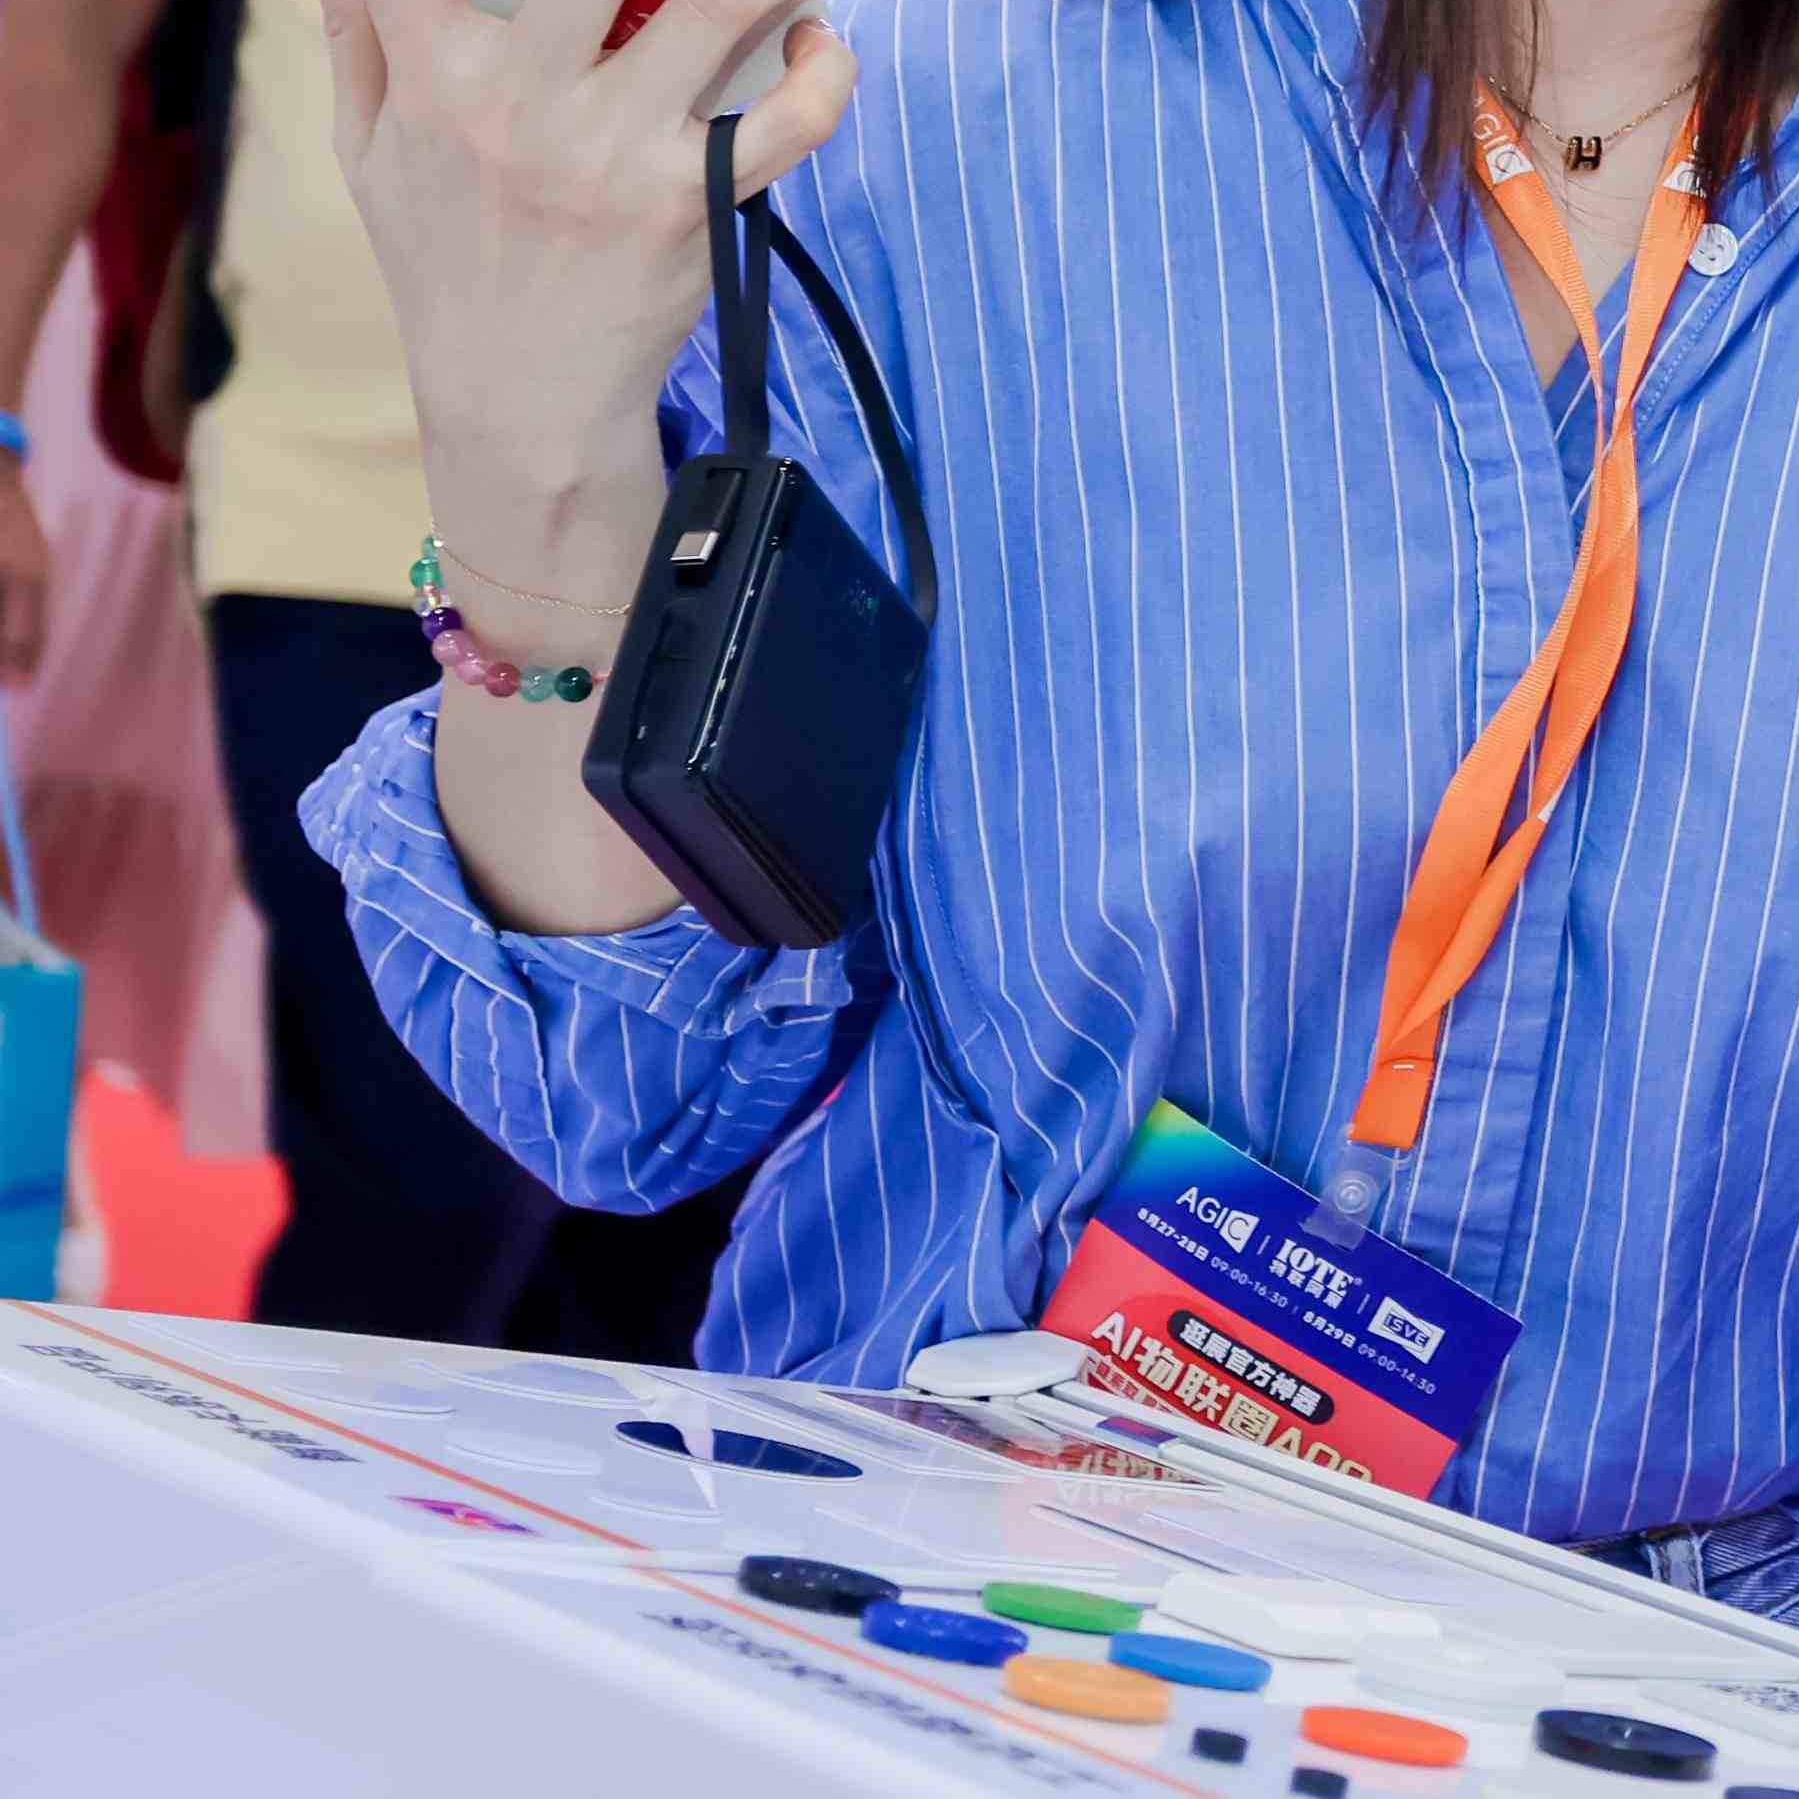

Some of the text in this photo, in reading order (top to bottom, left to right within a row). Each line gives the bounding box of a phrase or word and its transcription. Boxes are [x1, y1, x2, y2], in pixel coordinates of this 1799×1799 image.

[1176, 1186, 1256, 1249] AGIC
[1275, 1238, 1354, 1298] IOTE
[1384, 1313, 1431, 1349] ISVE
[1179, 1316, 1323, 1418] 逛展官方神器
